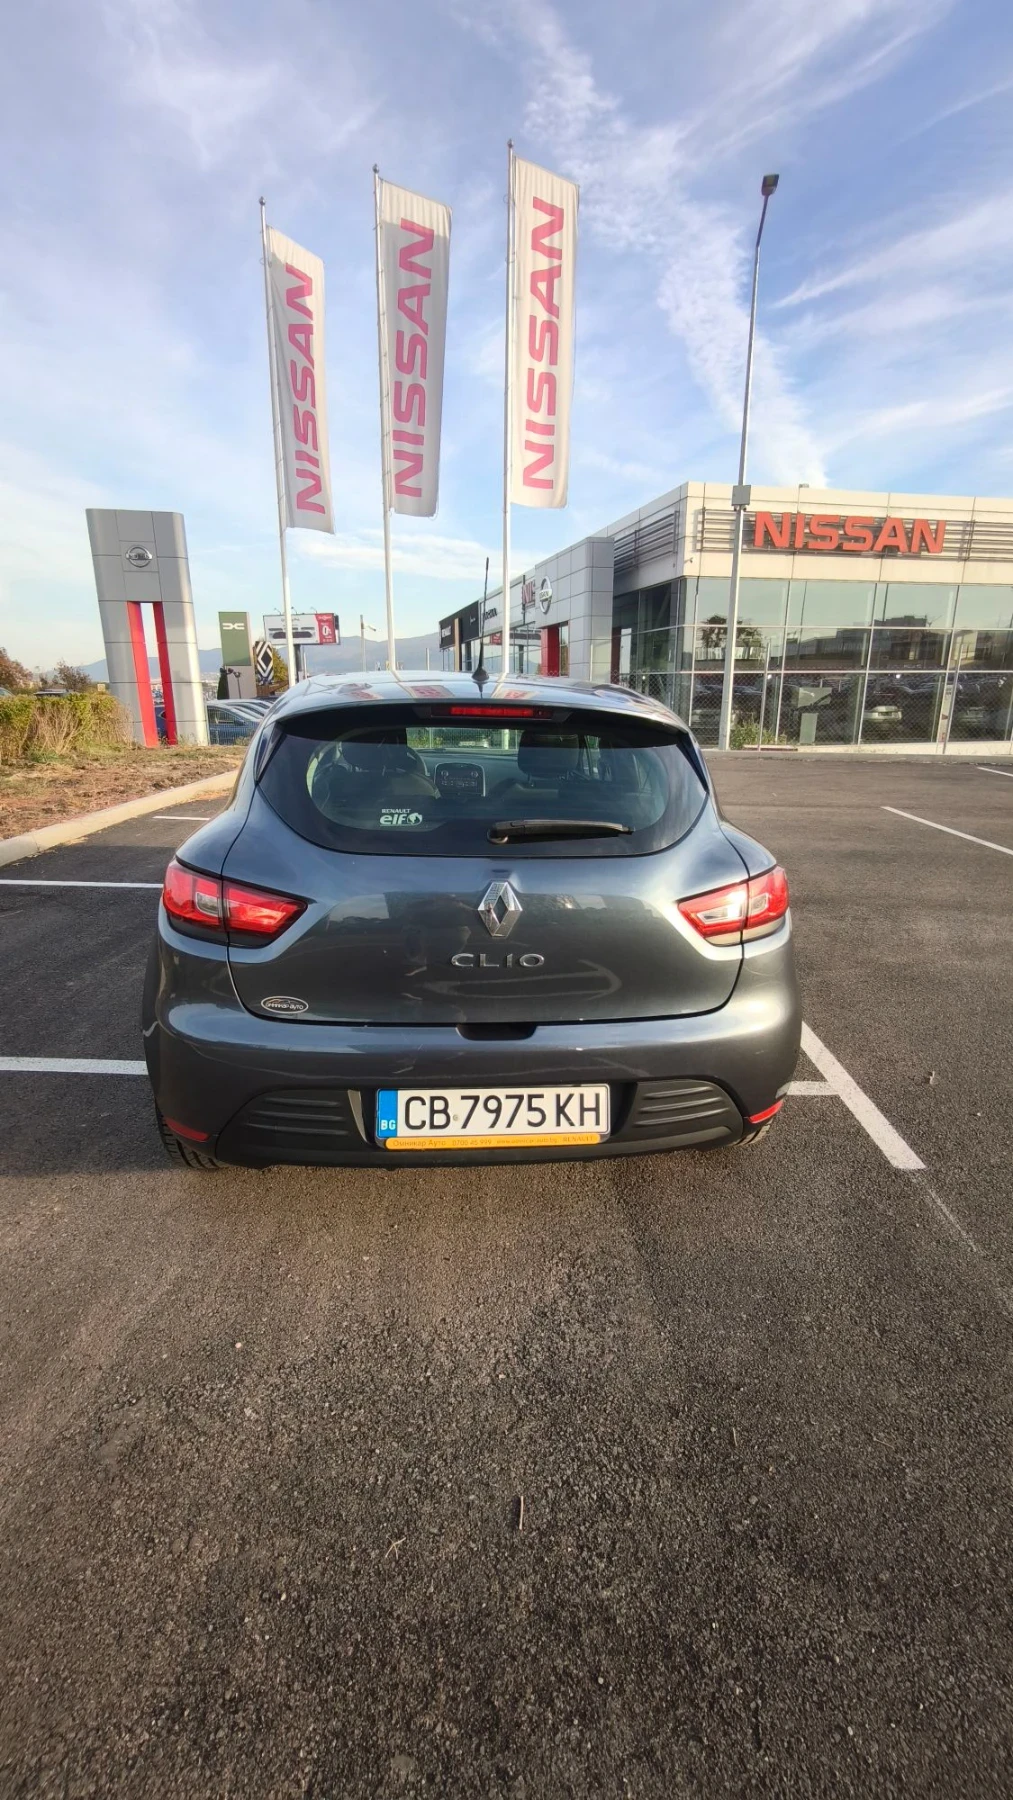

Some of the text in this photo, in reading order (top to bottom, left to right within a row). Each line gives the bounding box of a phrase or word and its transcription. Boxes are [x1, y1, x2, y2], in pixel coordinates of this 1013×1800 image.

[392, 217, 435, 498] NISSAN
[523, 196, 565, 490] NISSAN
[285, 262, 326, 515] NISSAN
[753, 511, 946, 554] NISSAN
[379, 813, 407, 825] elf
[451, 952, 545, 968] CLIO
[380, 1120, 396, 1131] BG
[404, 1092, 601, 1131] CB 7975 KH
